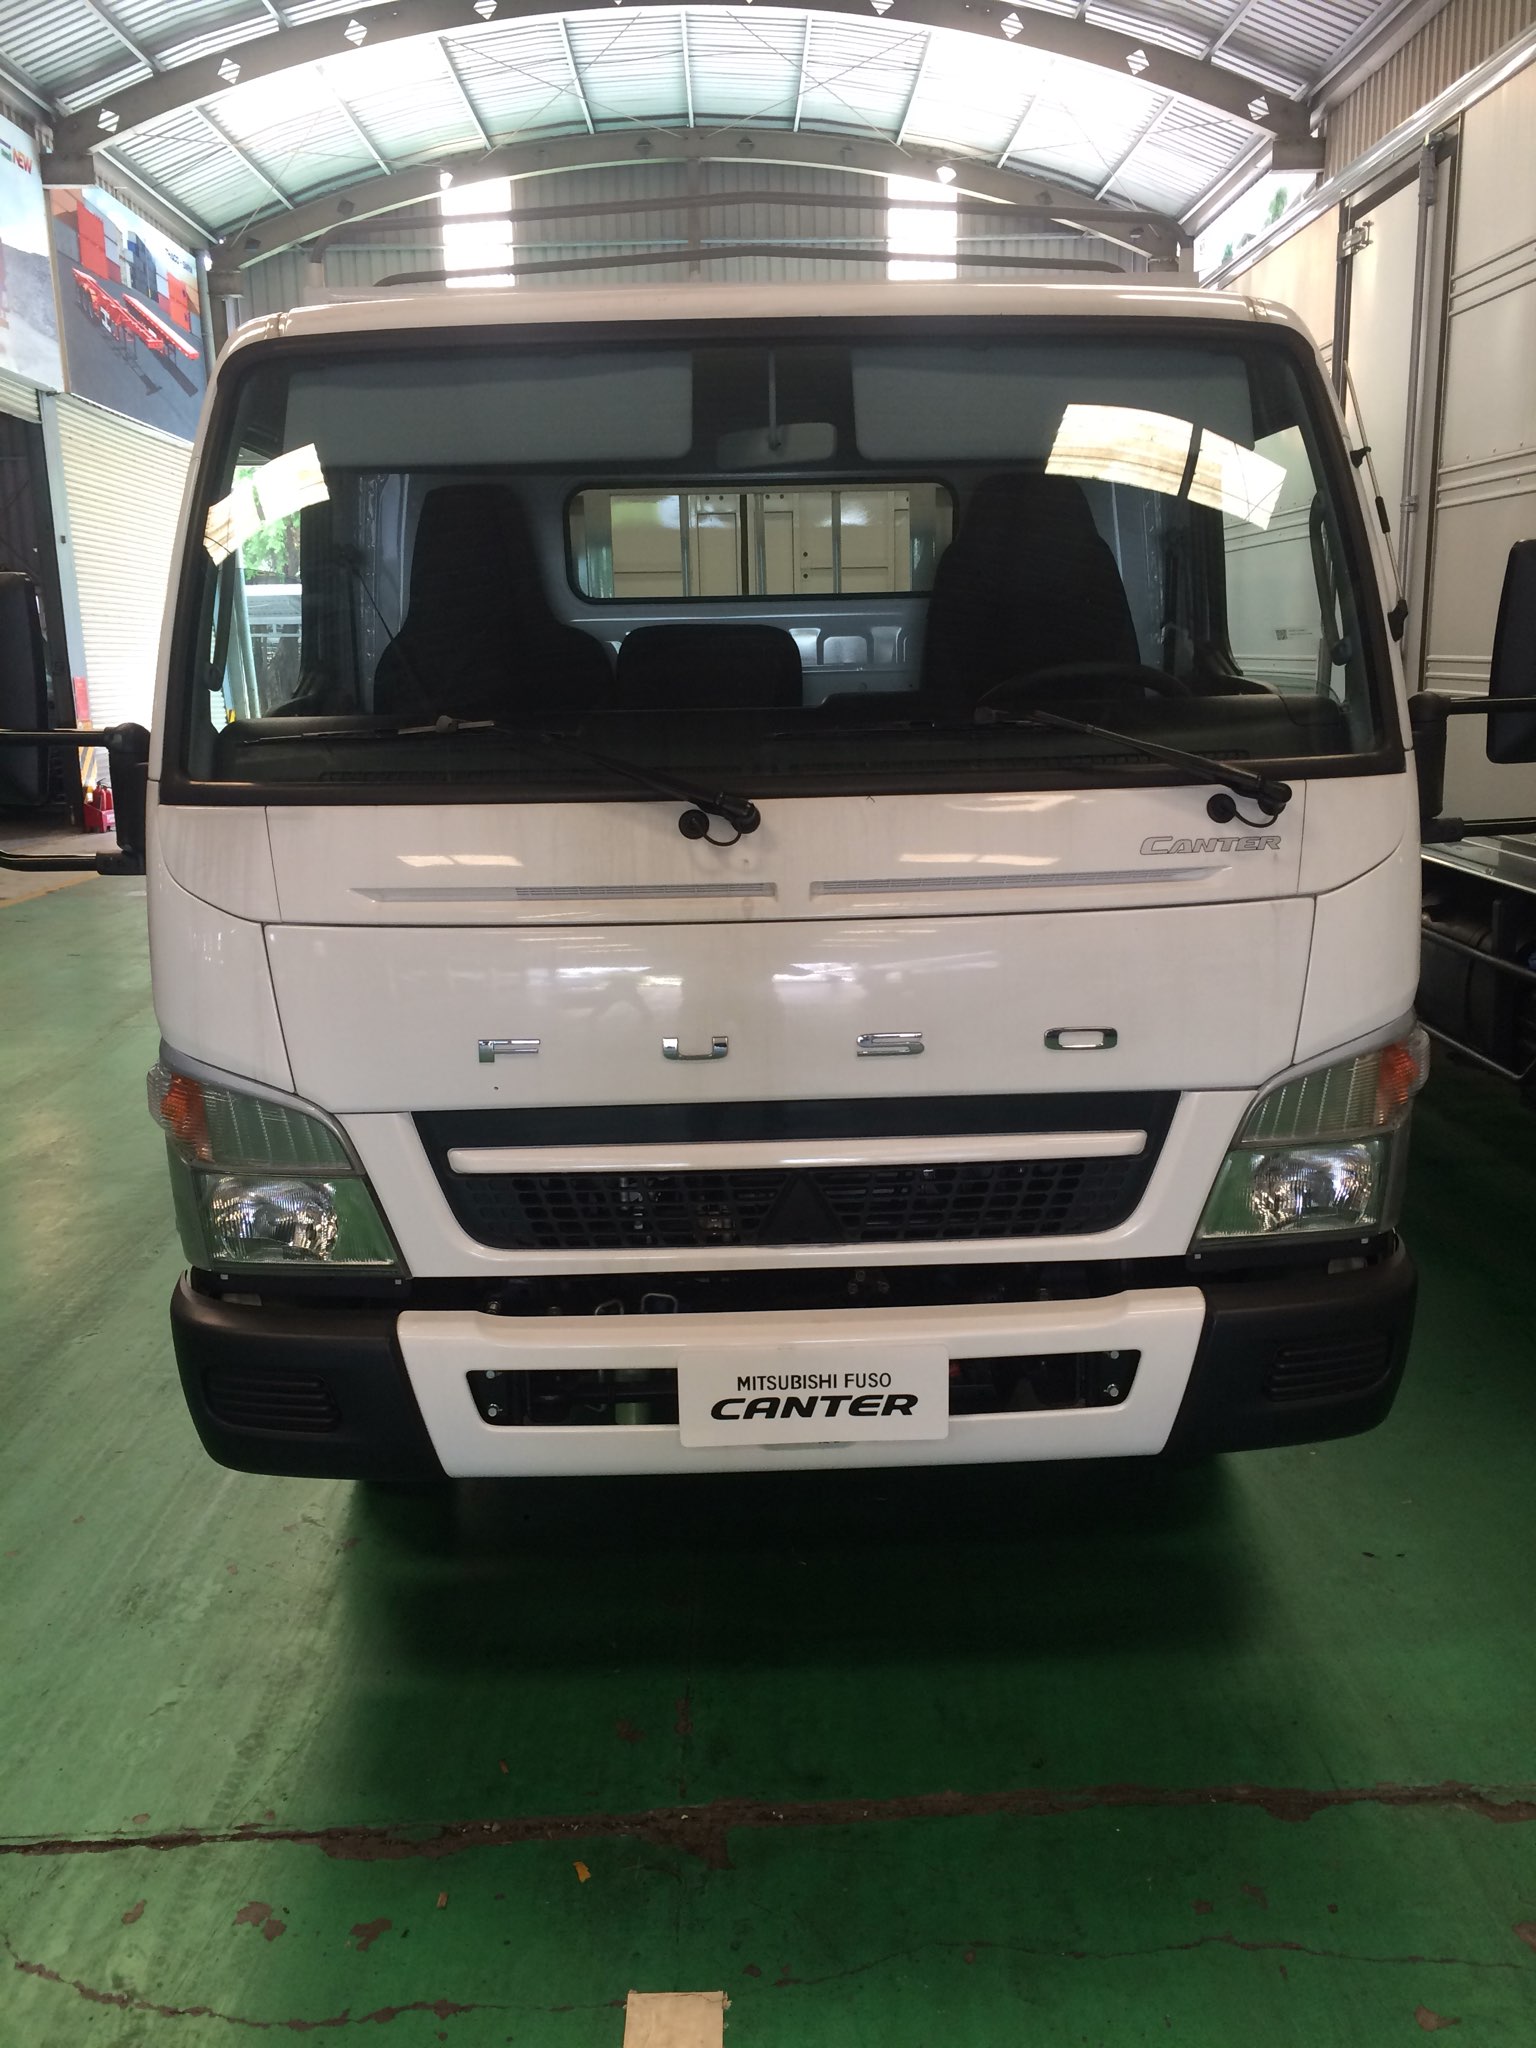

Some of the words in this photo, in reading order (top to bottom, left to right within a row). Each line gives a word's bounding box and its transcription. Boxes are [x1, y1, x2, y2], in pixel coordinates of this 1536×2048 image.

[1140, 835, 1282, 855] CANTER
[478, 1026, 1118, 1063] FUSO
[737, 1373, 838, 1391] MITSUBISHI
[844, 1372, 892, 1388] FUSO
[711, 1394, 919, 1421] CANTER
